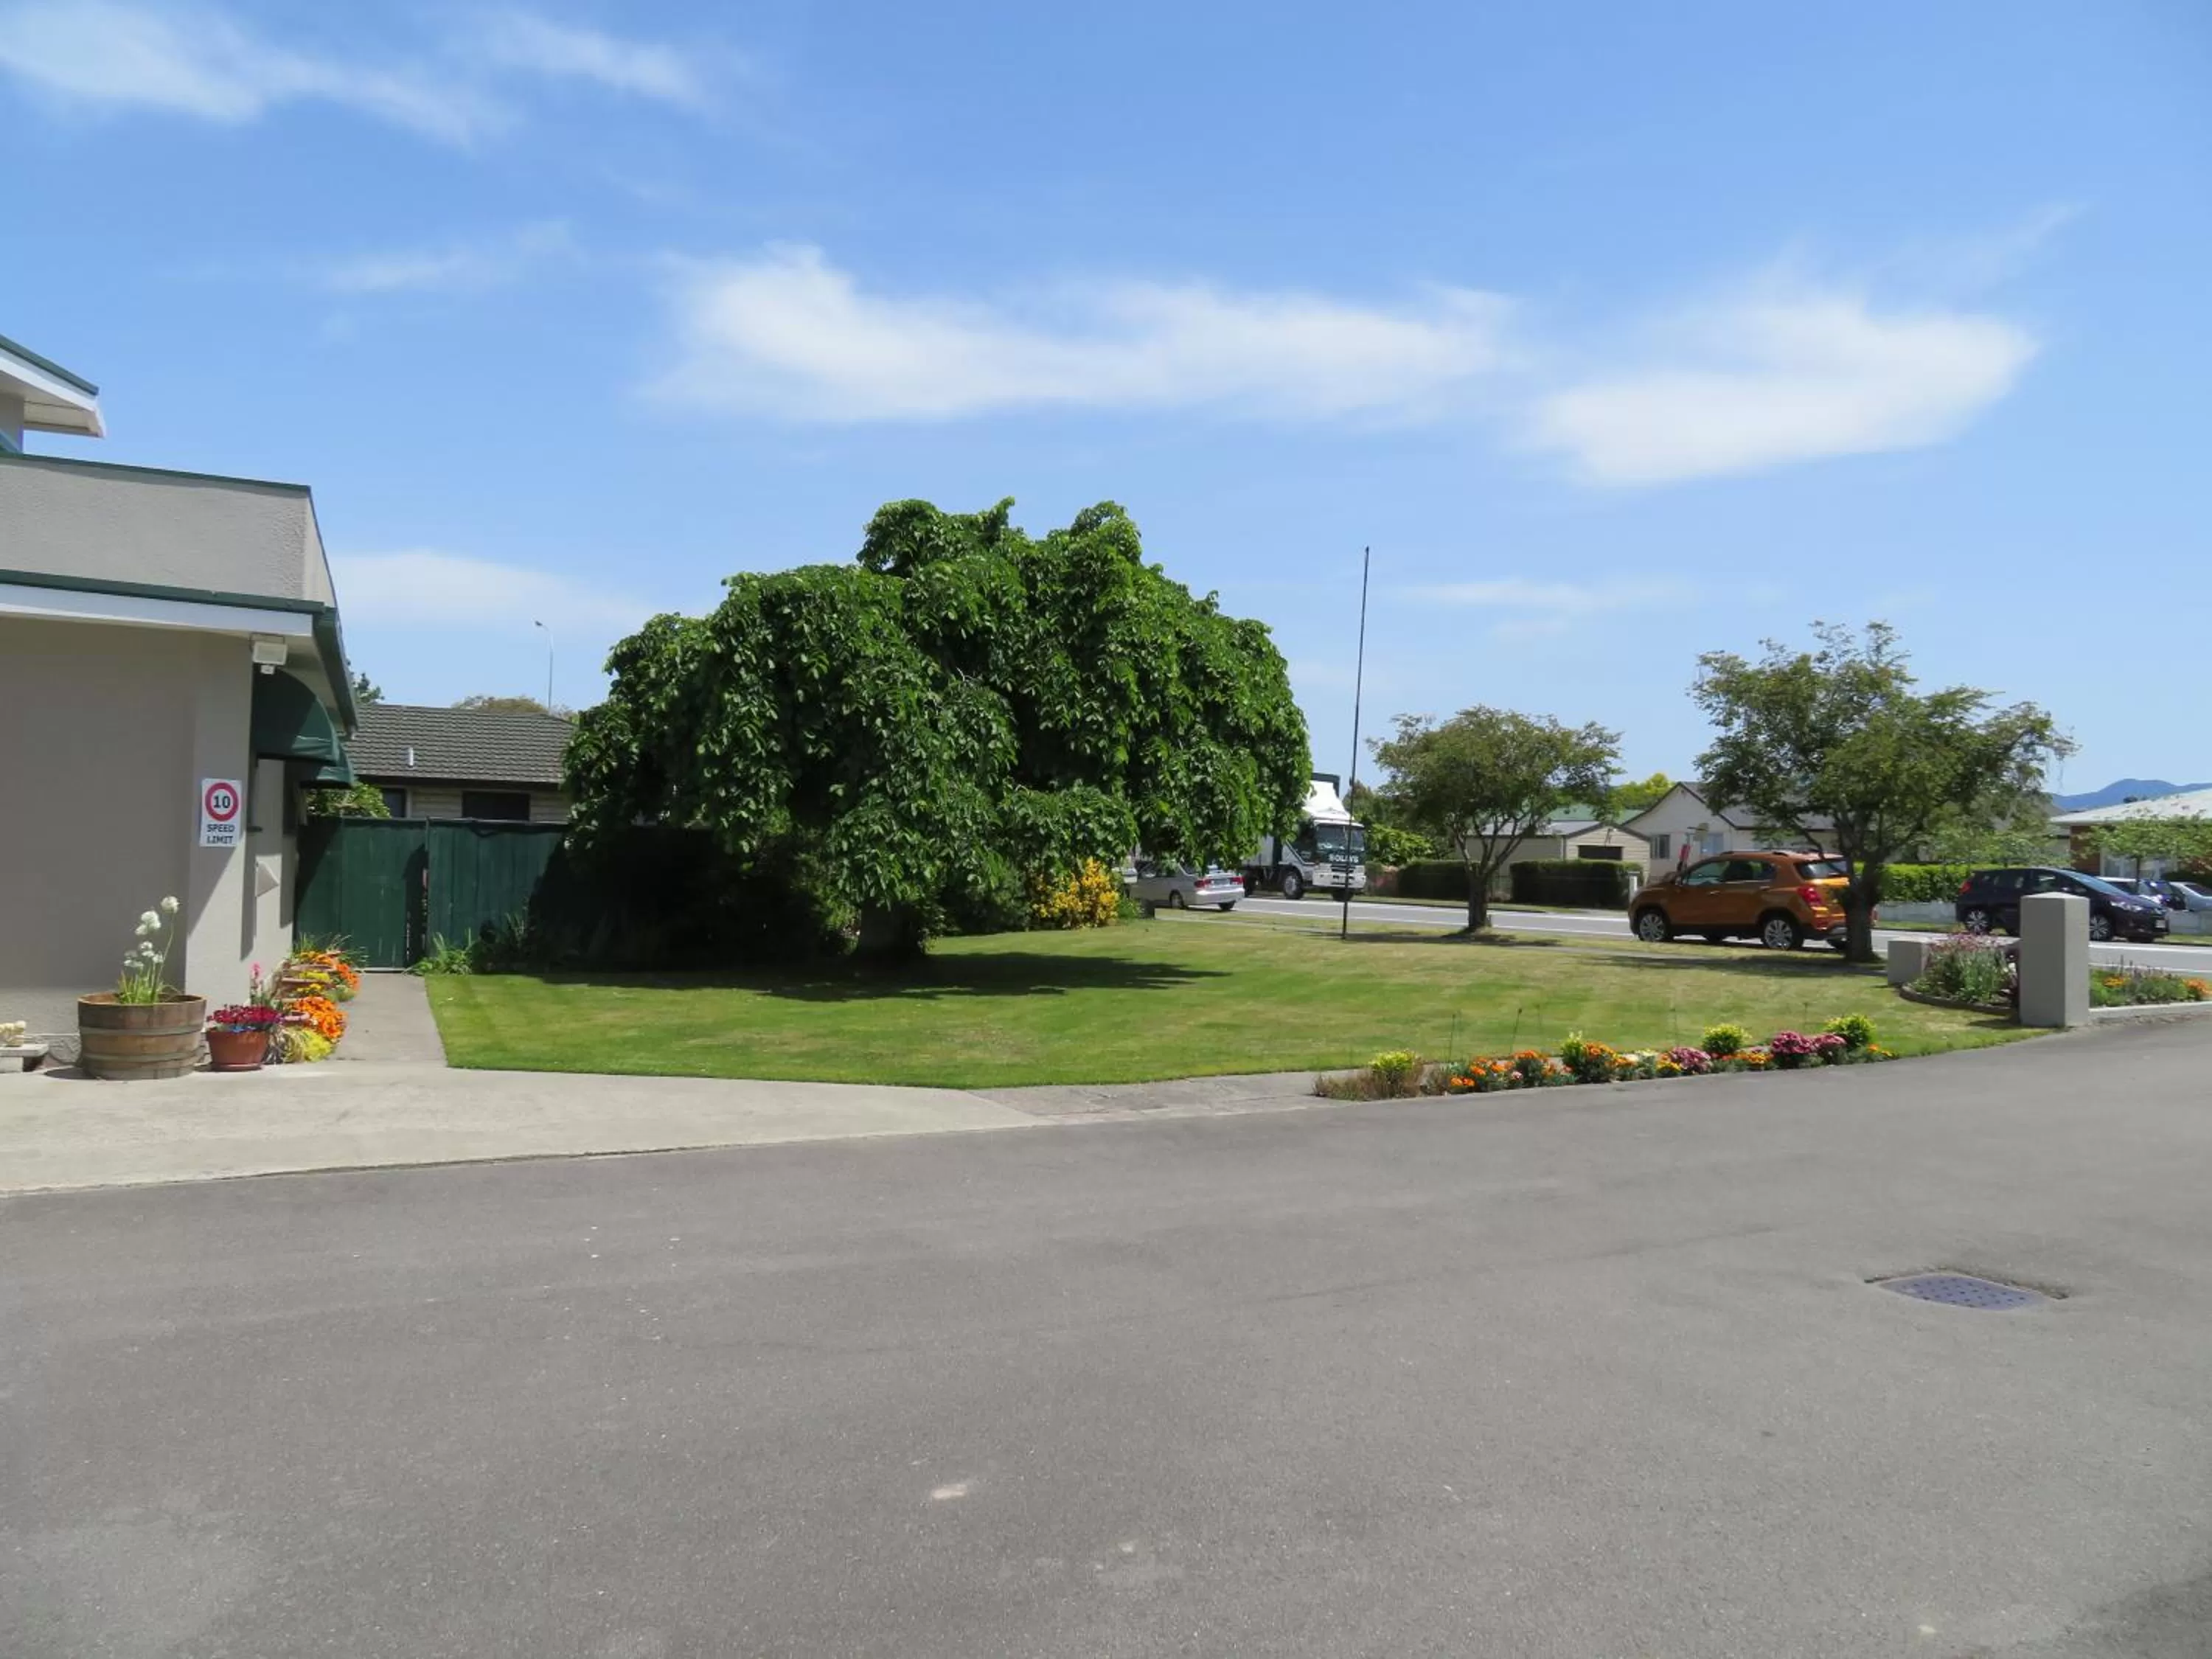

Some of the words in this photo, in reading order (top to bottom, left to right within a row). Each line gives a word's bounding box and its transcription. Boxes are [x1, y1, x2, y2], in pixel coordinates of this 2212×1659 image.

[213, 796, 231, 809] 10
[206, 824, 235, 832] SPEED
[206, 835, 234, 844] LIMIT
